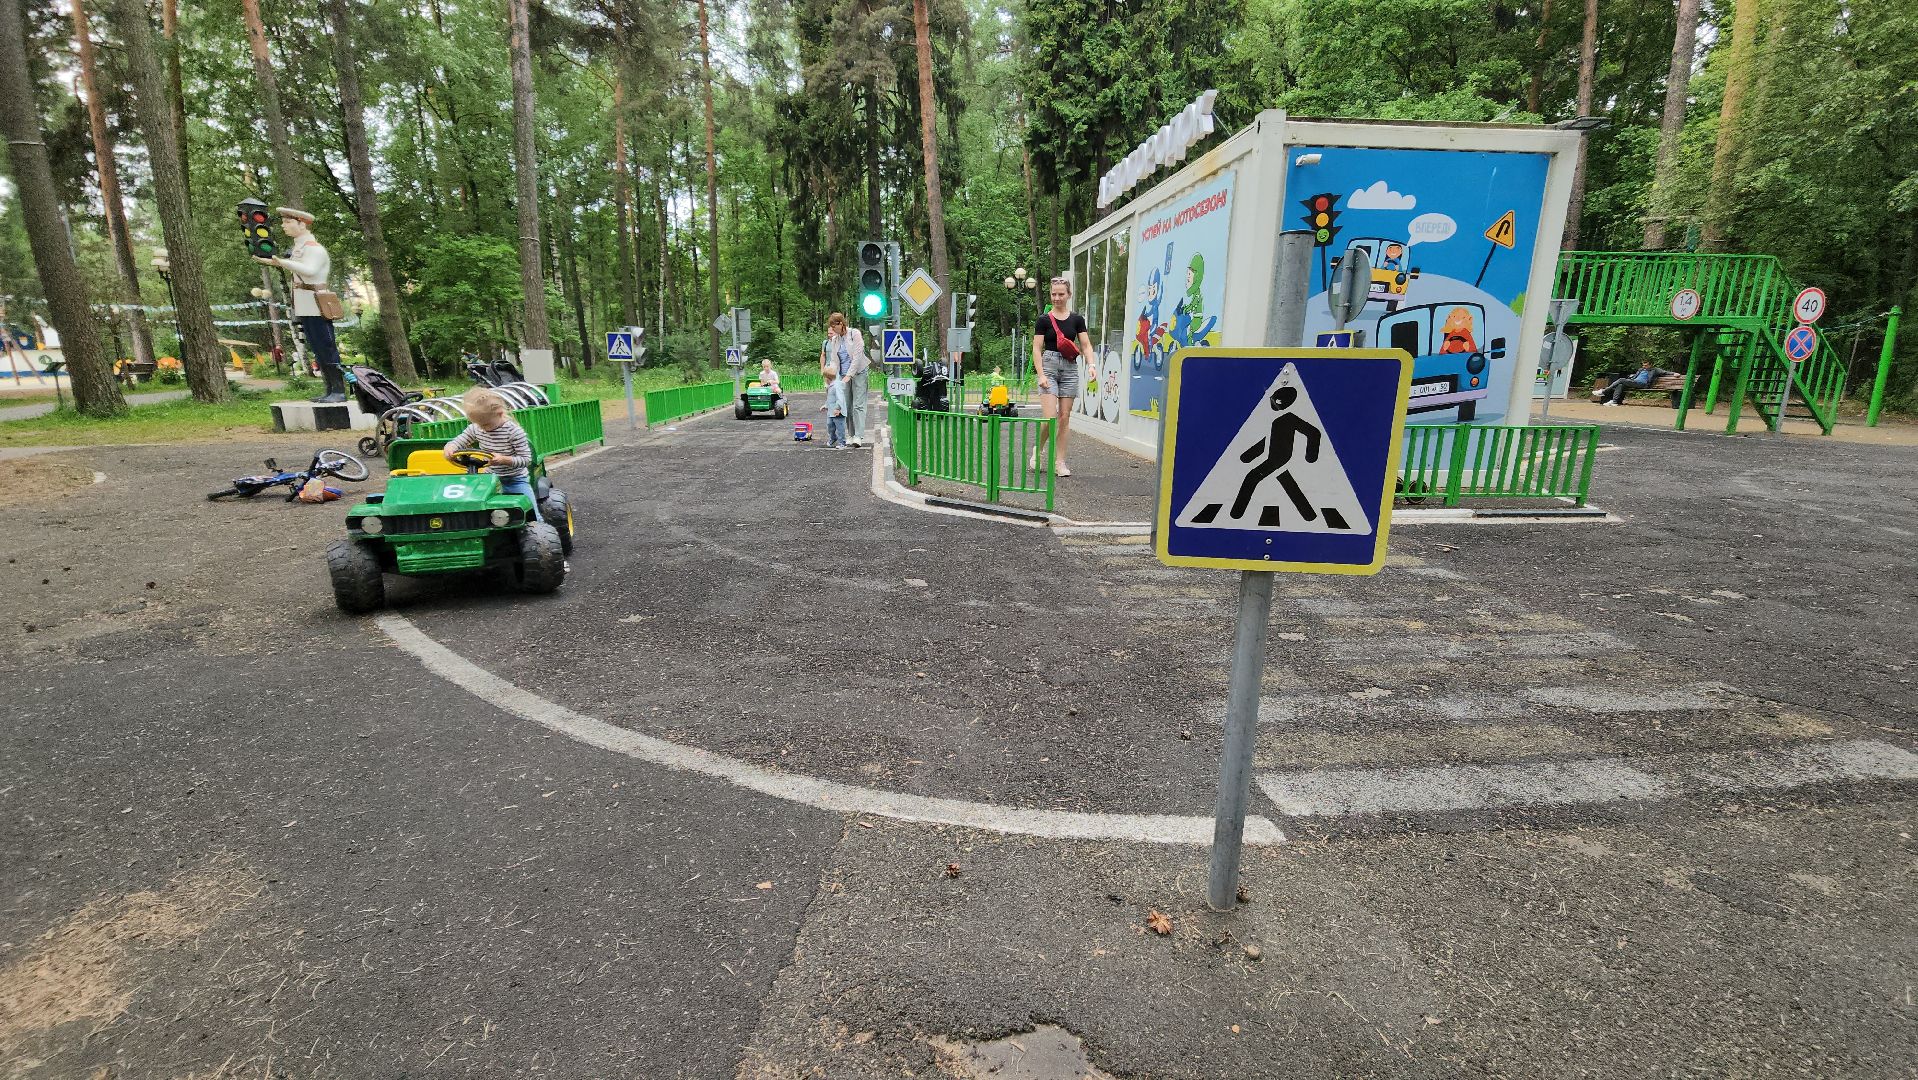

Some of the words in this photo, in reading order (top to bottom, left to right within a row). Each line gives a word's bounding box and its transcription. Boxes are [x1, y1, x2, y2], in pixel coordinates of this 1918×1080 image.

[1162, 216, 1172, 234] НА
[1802, 299, 1818, 312] 40
[443, 484, 466, 499] 6
